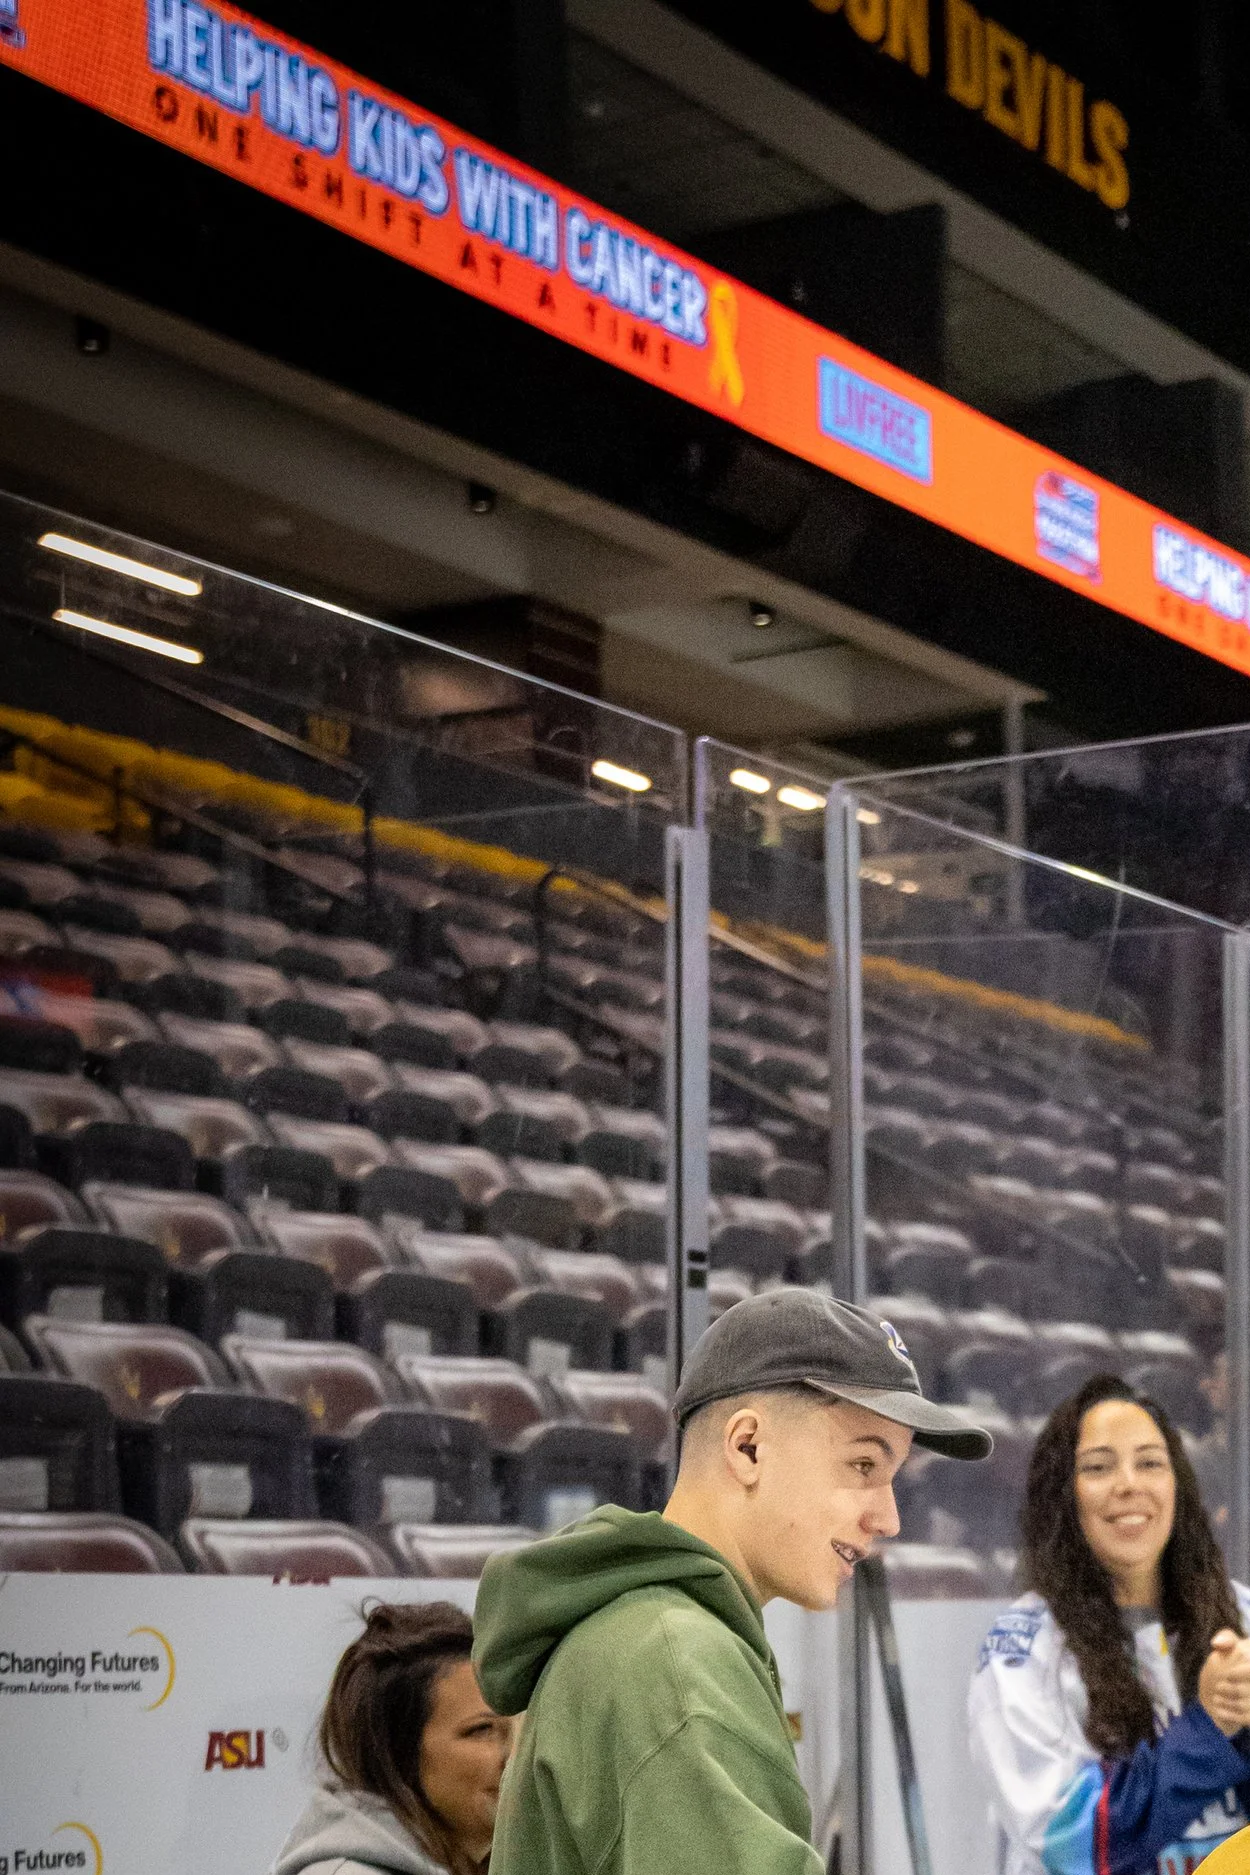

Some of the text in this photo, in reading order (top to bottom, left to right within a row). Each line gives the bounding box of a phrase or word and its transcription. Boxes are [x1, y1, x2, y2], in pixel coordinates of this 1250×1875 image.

[946, 0, 1130, 209] DEVILS
[148, 0, 708, 349] HELPING KIDS WITH CANCER
[459, 240, 504, 286] AT
[537, 281, 556, 313] A
[0, 1651, 160, 1677] Changing Futures
[74, 1681, 92, 1694] For
[94, 1680, 110, 1693] the
[204, 1728, 265, 1772] ASU
[14, 1849, 86, 1872] Futures
